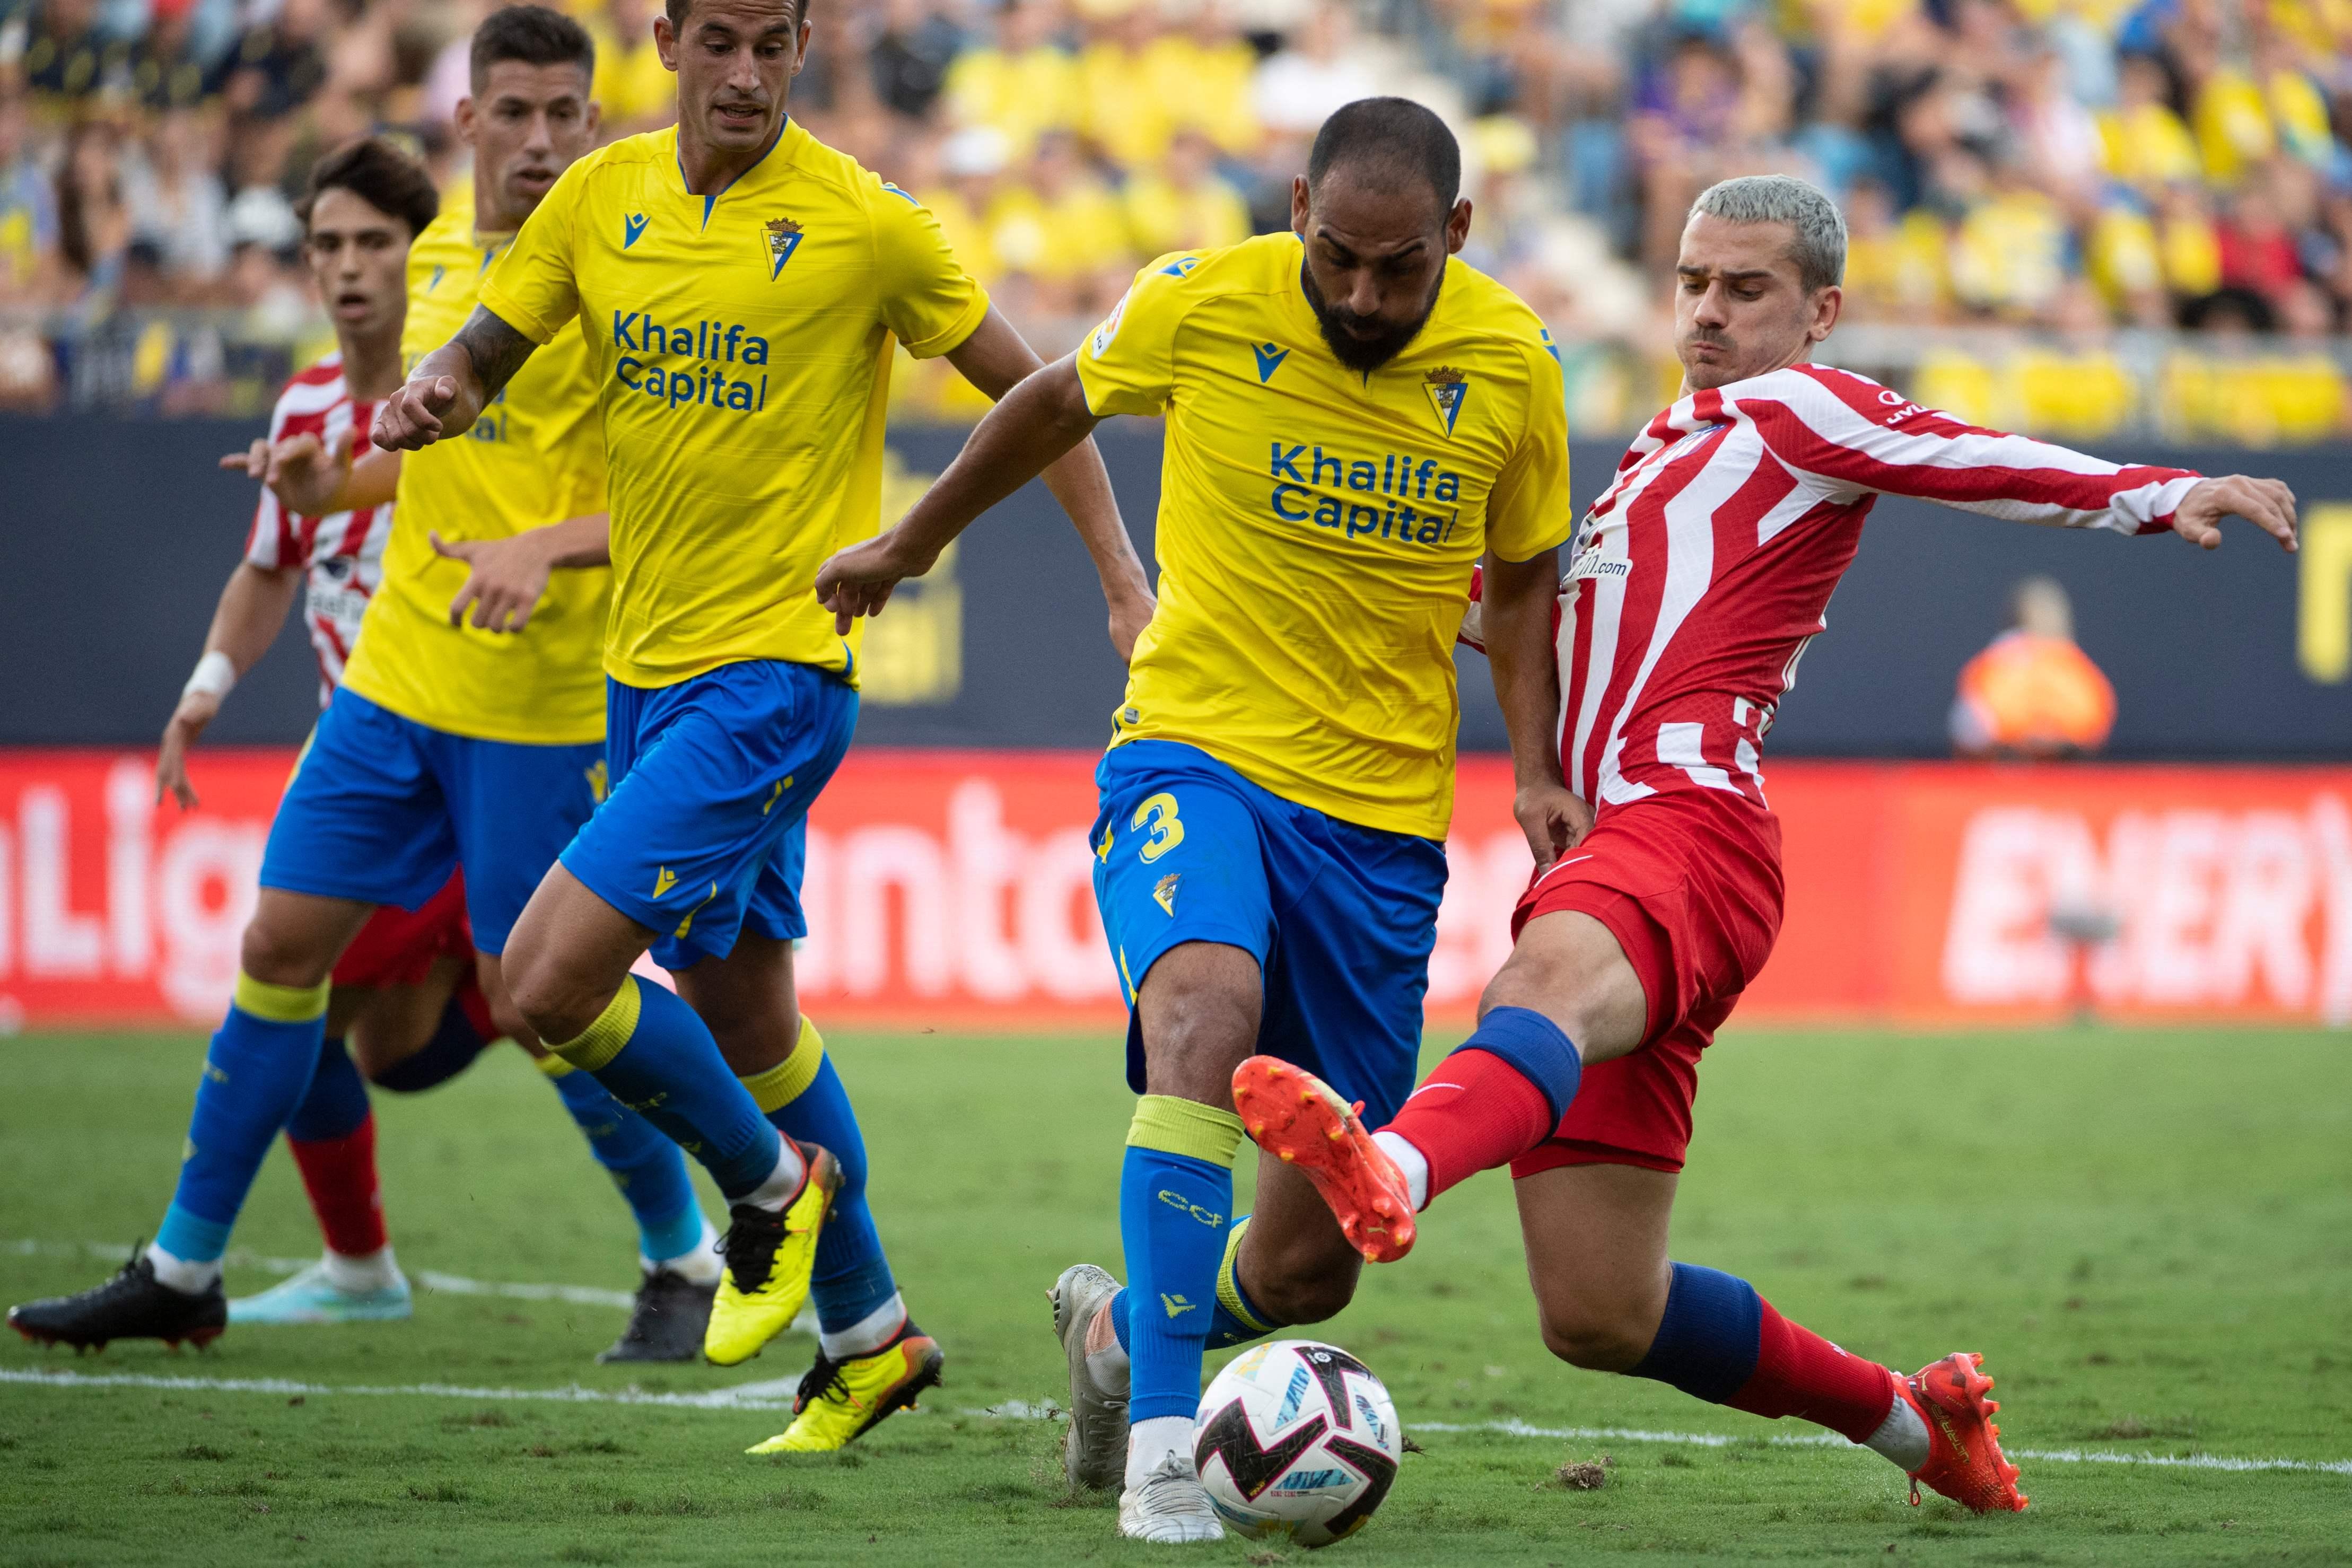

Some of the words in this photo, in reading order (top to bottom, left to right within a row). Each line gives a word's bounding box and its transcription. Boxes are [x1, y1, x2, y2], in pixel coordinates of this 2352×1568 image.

[614, 310, 768, 365] Khalifa
[616, 356, 767, 411] Capital
[1271, 442, 1459, 502] Khalifa
[1271, 483, 1458, 544] Capital
[1131, 792, 1185, 864] 3
